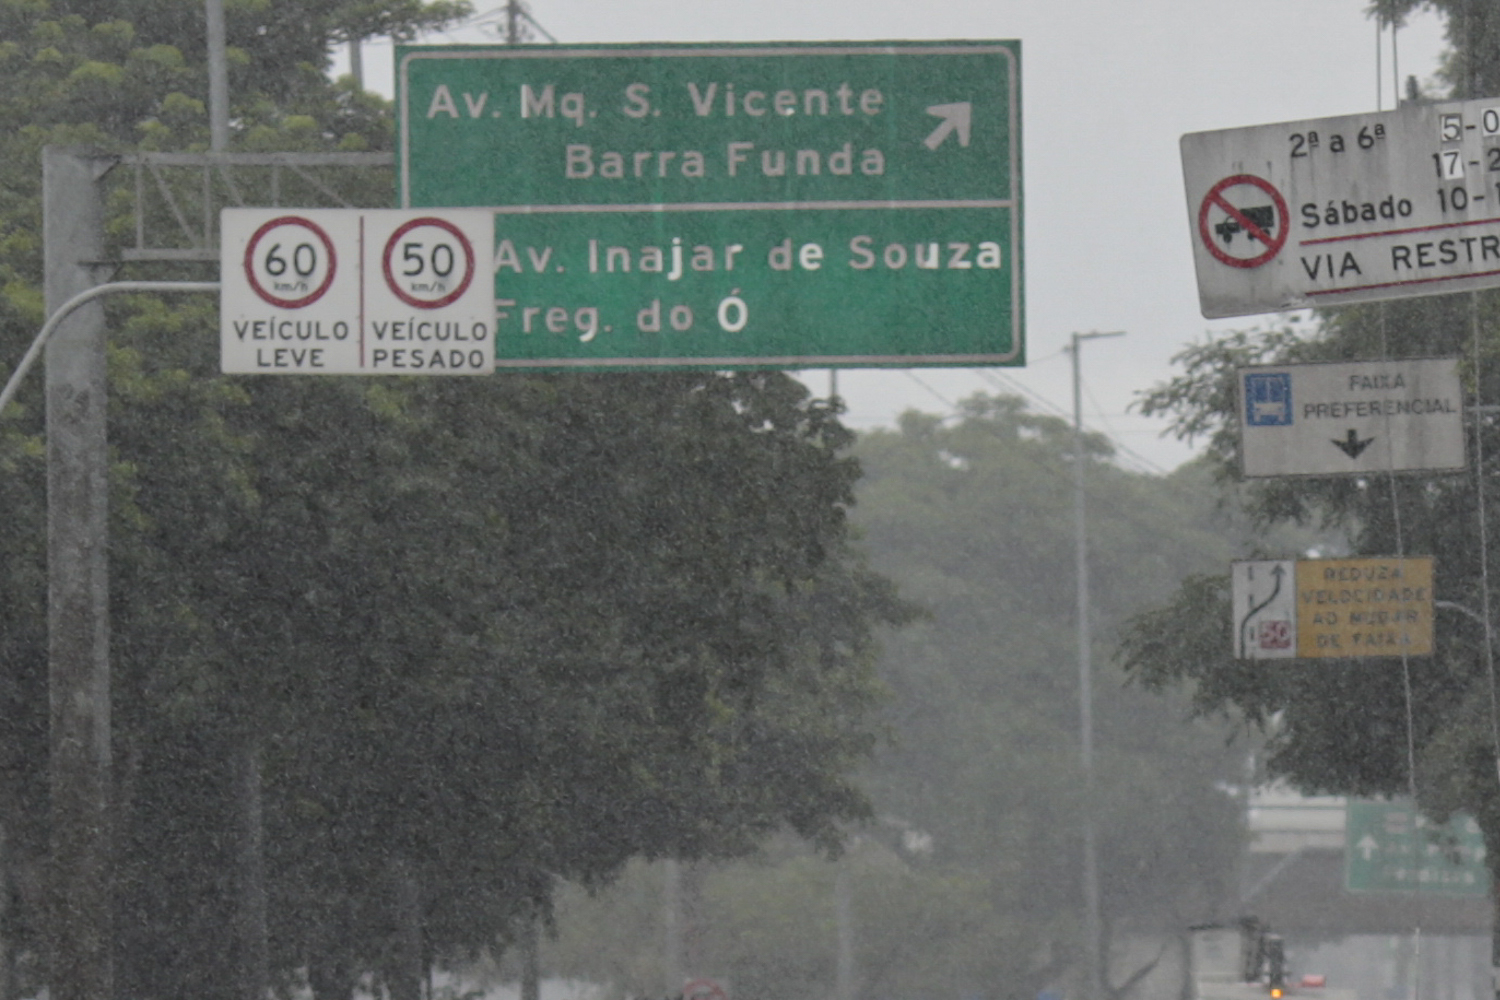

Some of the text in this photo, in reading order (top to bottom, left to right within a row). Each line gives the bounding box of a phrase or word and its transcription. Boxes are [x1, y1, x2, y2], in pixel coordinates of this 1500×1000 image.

[426, 80, 885, 127] Av. Mq. S. Vicente
[1329, 133, 1345, 153] a
[565, 141, 886, 179] Barra Funda
[1301, 194, 1413, 229] Sábado
[265, 242, 317, 277] 60
[402, 242, 455, 277] 50
[494, 235, 1002, 281] Av. Inajar de Souza
[1301, 251, 1363, 281] VIA
[273, 280, 309, 293] km/h
[410, 280, 446, 293] km/h
[635, 299, 694, 333] do
[717, 287, 750, 333] Ó
[233, 316, 349, 342] VEÍCULO
[372, 317, 488, 342] VEÍCULO
[256, 349, 325, 368] LEVE
[372, 349, 485, 369] PESADO
[1349, 373, 1406, 391] FAIXA
[1303, 398, 1457, 420] PREFERENCIAL
